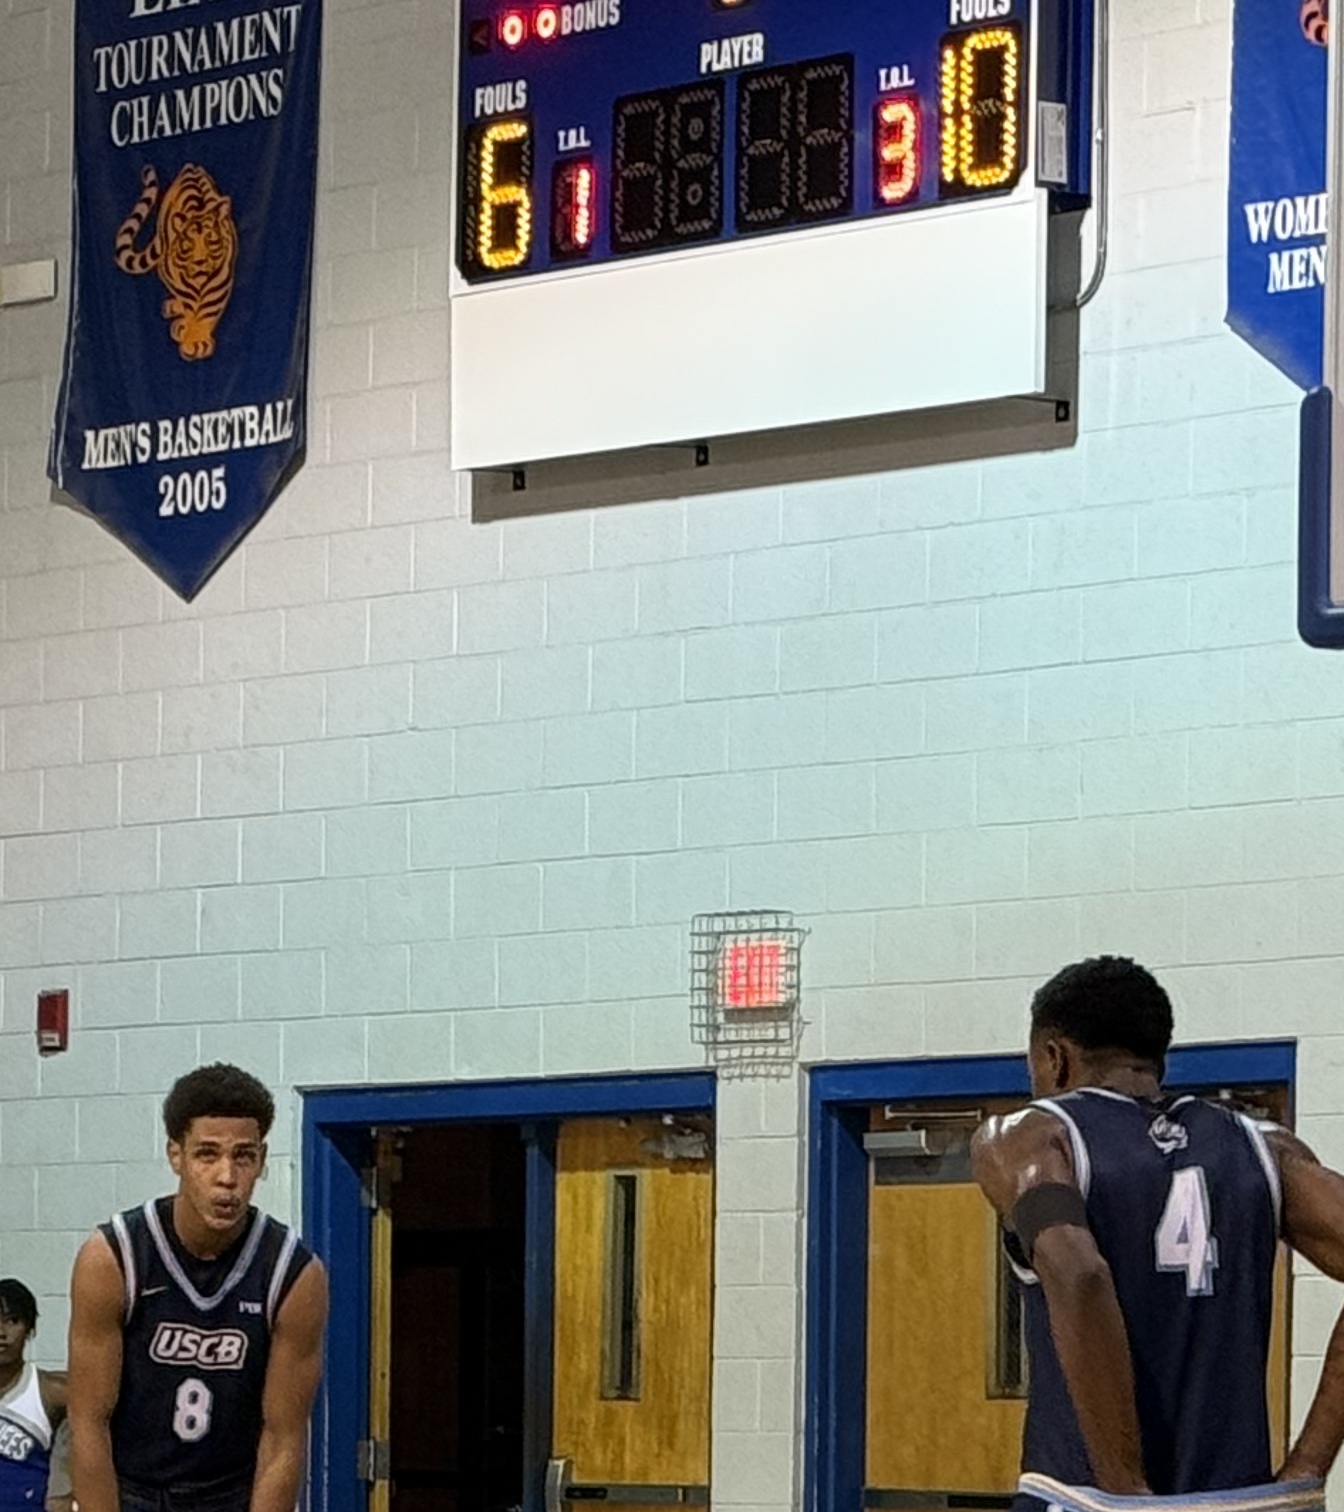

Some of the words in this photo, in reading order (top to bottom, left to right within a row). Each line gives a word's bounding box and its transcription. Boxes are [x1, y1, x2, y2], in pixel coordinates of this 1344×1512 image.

[93, 4, 302, 93] TOURNAMENT
[561, 0, 620, 35] BONUS
[700, 33, 764, 74] PLAYER
[111, 68, 284, 147] CHAMPIONS
[474, 80, 527, 118] FOULS
[881, 102, 915, 203] 3
[480, 120, 531, 270] 6
[81, 421, 151, 469] MEN'S
[157, 398, 295, 461] BASKETBALL
[159, 464, 227, 517] 2005
[1156, 1166, 1219, 1297] 4
[153, 1327, 245, 1365] USCB
[173, 1378, 213, 1442] 8
